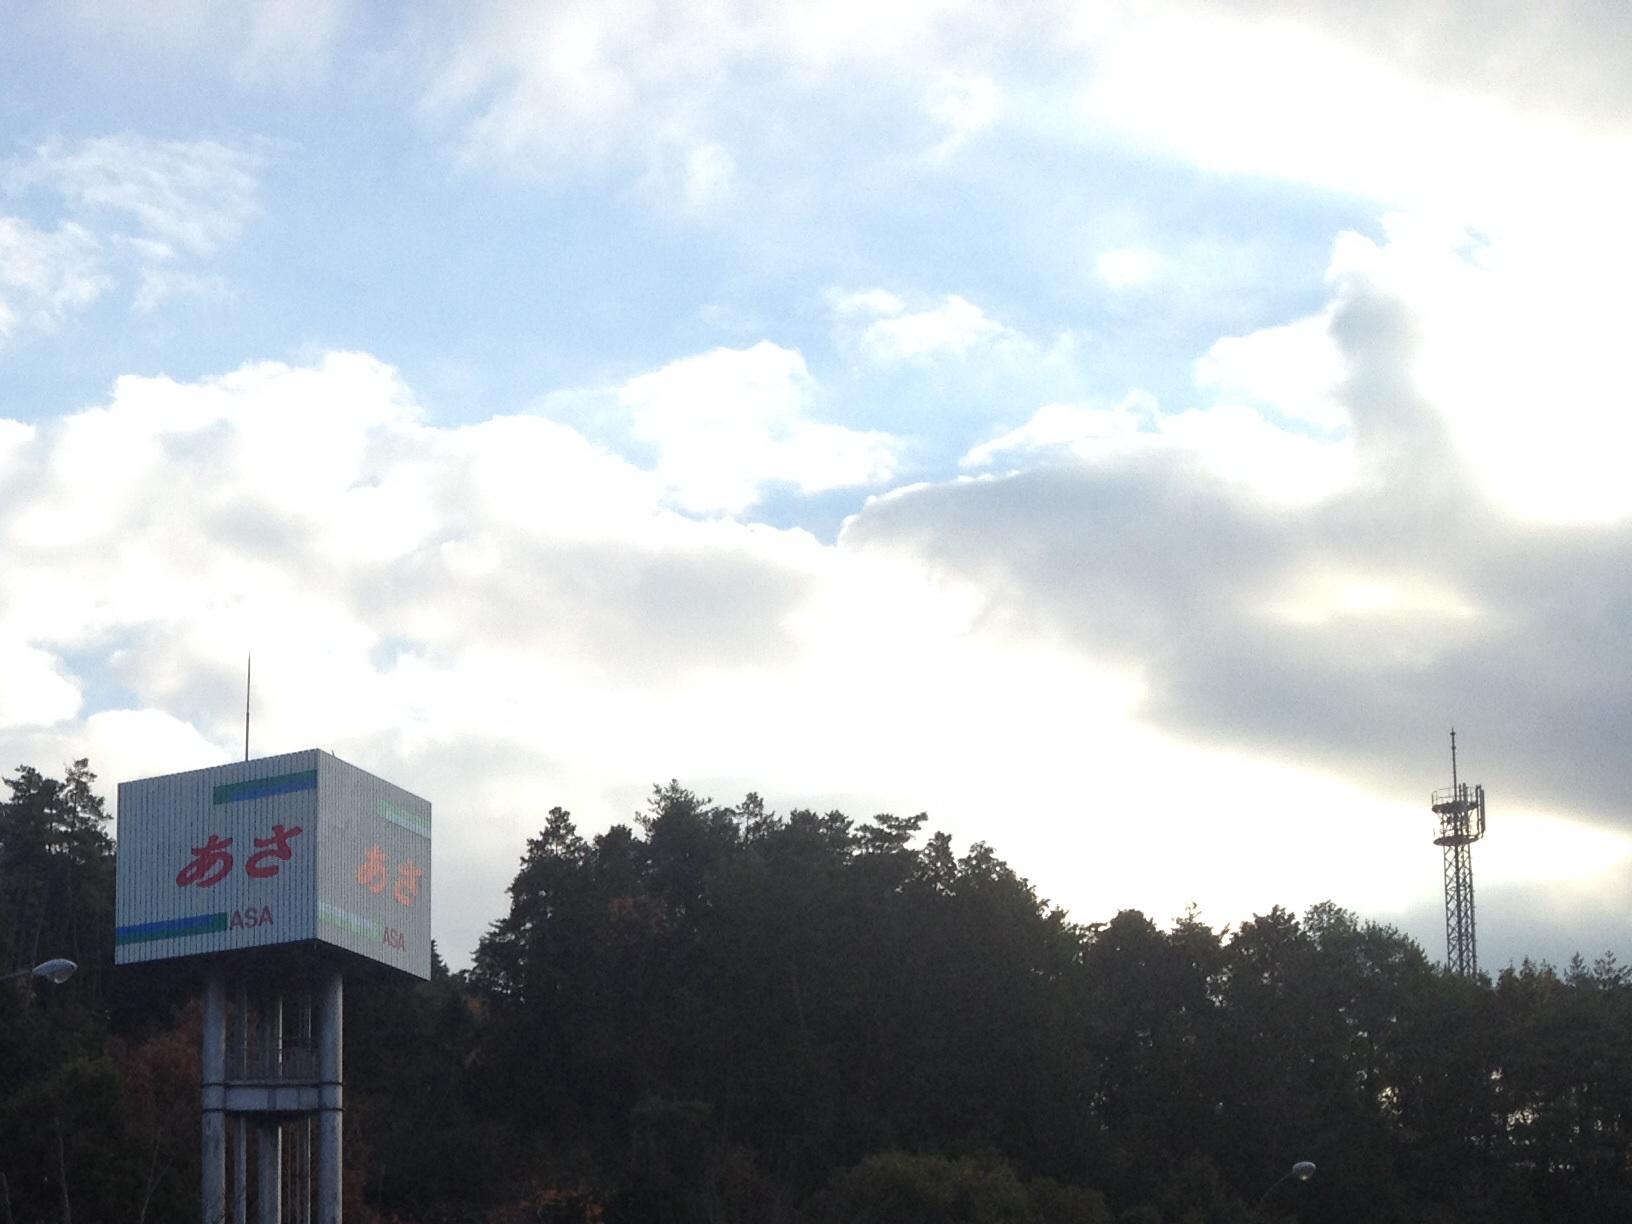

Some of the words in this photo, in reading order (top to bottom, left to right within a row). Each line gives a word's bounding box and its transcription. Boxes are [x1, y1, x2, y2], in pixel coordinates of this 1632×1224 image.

[176, 824, 303, 888] あさ
[357, 844, 423, 907] あさ
[230, 906, 273, 930] ASA
[383, 928, 406, 952] ASA
